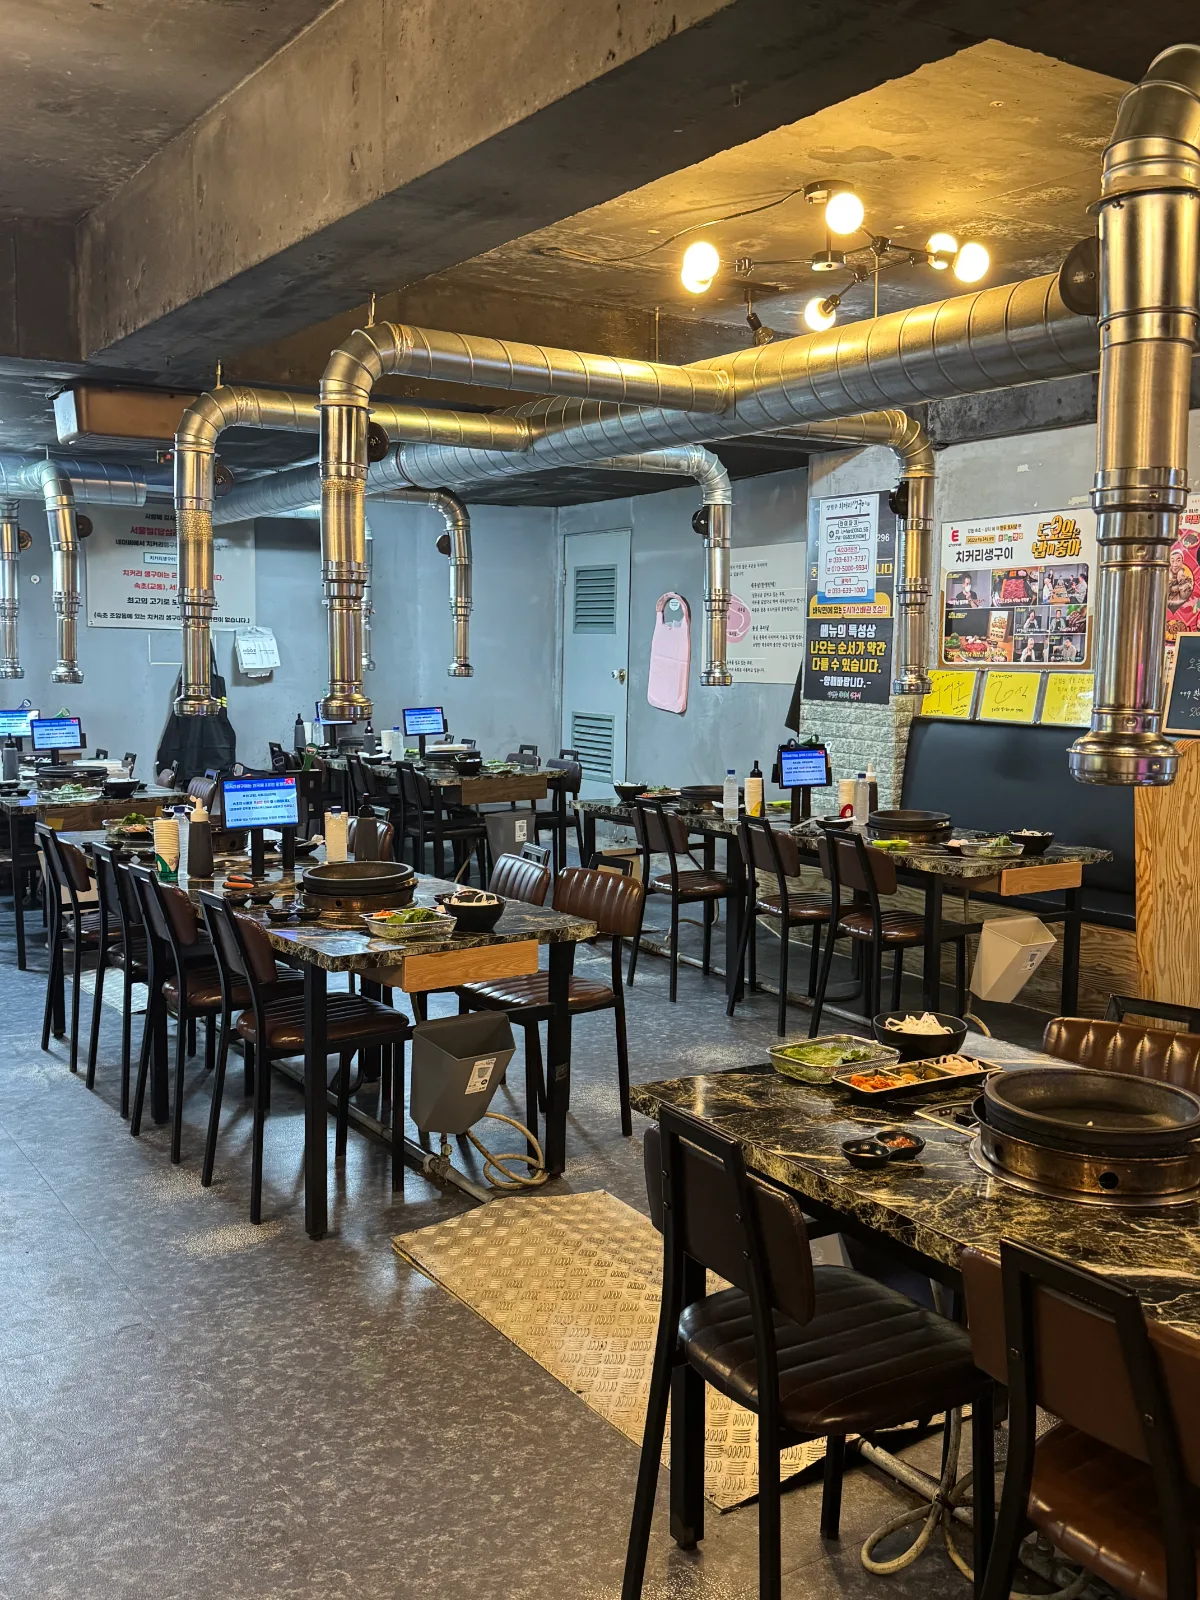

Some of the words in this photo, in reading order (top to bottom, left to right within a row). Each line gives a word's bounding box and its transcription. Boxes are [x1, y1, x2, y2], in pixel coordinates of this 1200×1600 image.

[955, 546, 1014, 563] 치커리생구이
[134, 583, 168, 591] 속초(교동),
[110, 612, 133, 620] 조양동에
[147, 613, 164, 621] 치커리
[820, 624, 846, 638] 메뉴의
[849, 624, 876, 638] 특성상
[810, 641, 836, 654] 나오는
[837, 641, 865, 655] 순서가
[867, 641, 886, 656] 약간
[812, 657, 829, 671] 다를
[831, 658, 840, 671] 수
[841, 658, 882, 673] 있습니다.
